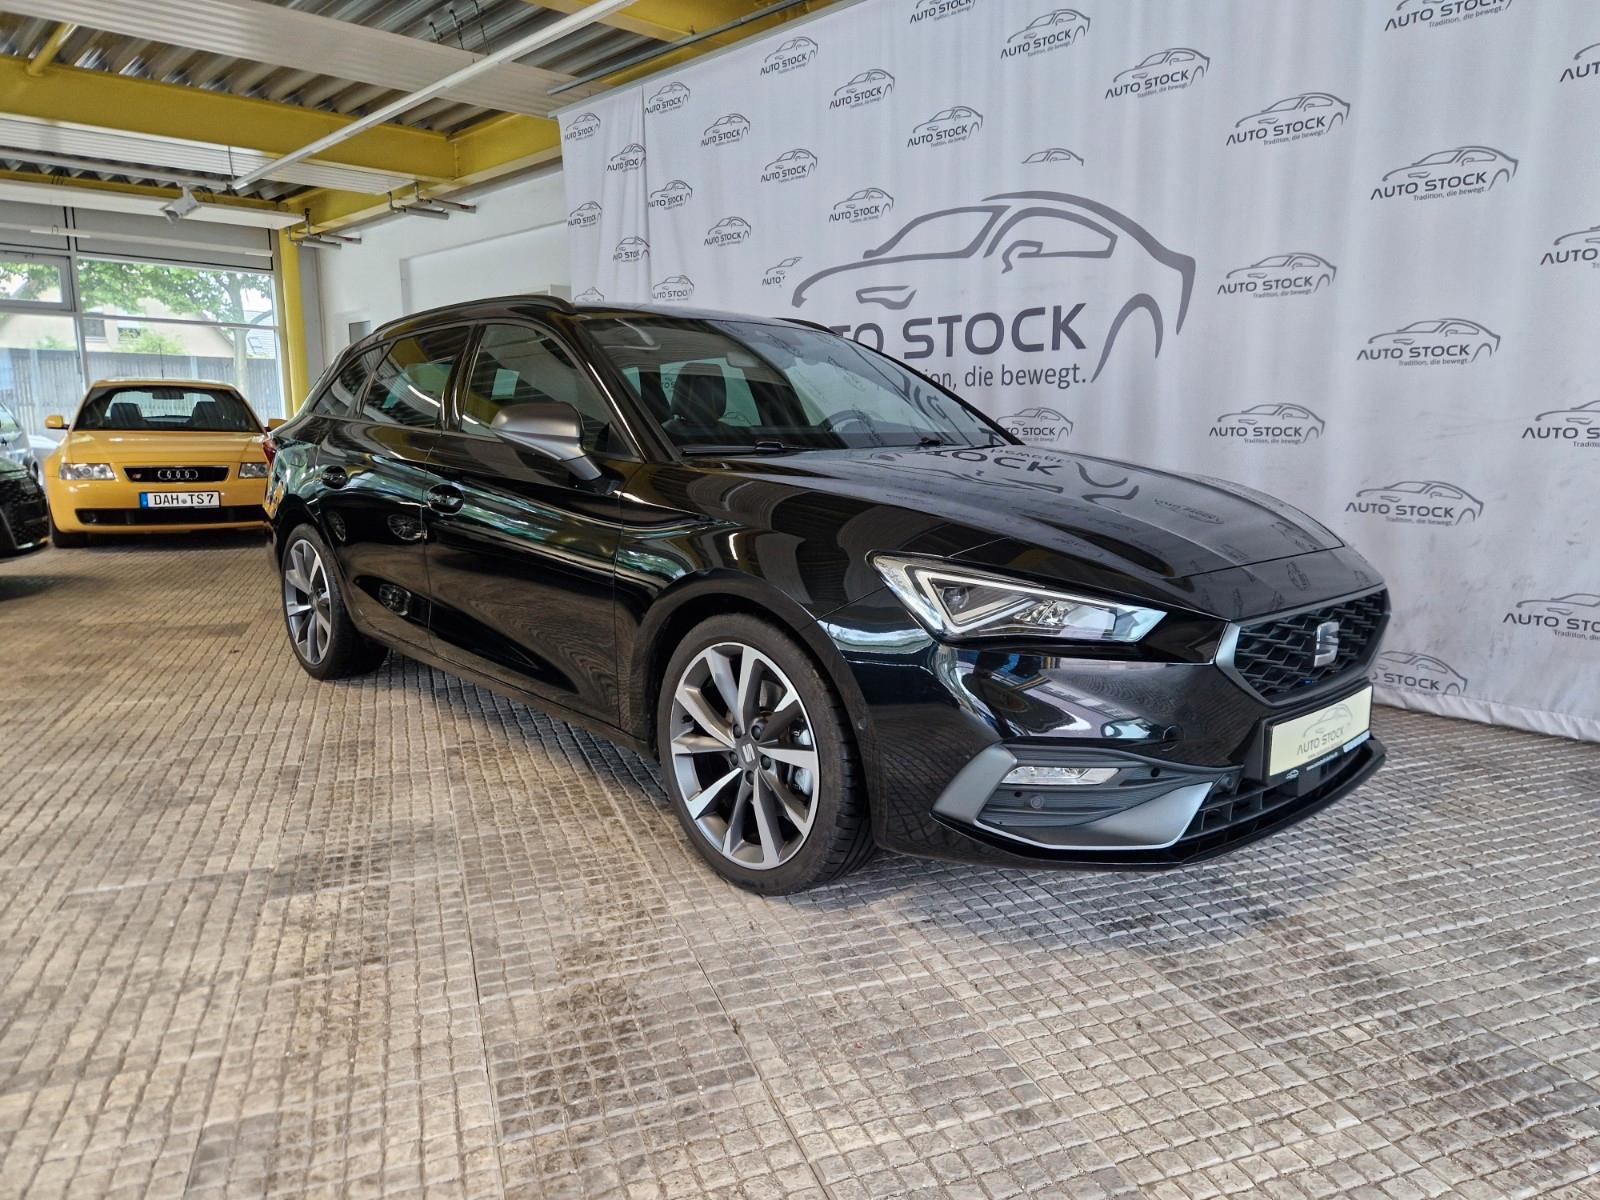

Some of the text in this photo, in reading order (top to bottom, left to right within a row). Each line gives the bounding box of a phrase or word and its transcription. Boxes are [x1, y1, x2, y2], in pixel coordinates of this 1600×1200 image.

[909, 8, 936, 24] AUTO
[1384, 0, 1501, 31] AUTO STO
[1000, 29, 1072, 59] AUTO STOCK
[760, 62, 780, 76] AUTO
[782, 52, 807, 68] STOCK
[1560, 61, 1600, 82] AUT
[1105, 69, 1189, 99] AUTO STOCK
[829, 96, 852, 110] AUTO
[854, 86, 882, 103] STOCK
[700, 136, 716, 147] AUTO
[718, 129, 741, 142] STOCK
[907, 133, 933, 148] AUTO
[936, 124, 968, 141] STOCK
[1226, 115, 1326, 146] AUTO STOCK
[760, 169, 780, 183] AUTO
[782, 164, 807, 179] STOCK
[1370, 171, 1487, 201] AUTO STOCK
[828, 211, 852, 223] AUTO
[853, 204, 881, 218] STOCK
[704, 235, 720, 246] AUTO
[720, 231, 742, 243] STOCK
[1540, 248, 1599, 266] AUTO
[762, 276, 781, 286] AUTO
[1217, 275, 1313, 295] AUTO STOCK
[902, 303, 1087, 359] STOCK
[1356, 344, 1471, 361] AUTO STOCK
[964, 365, 994, 387] die
[1001, 363, 1087, 390] bewegt.
[1022, 427, 1056, 436] STOCK
[1209, 426, 1303, 437] AUTO STOCK
[1522, 427, 1579, 440] AUTO
[154, 493, 214, 505] DAH TS 7
[1345, 502, 1454, 519] AUTO STOCK
[1502, 612, 1600, 633] AUTO STO
[1383, 672, 1440, 690] STOCK
[1296, 738, 1320, 756] AUTO
